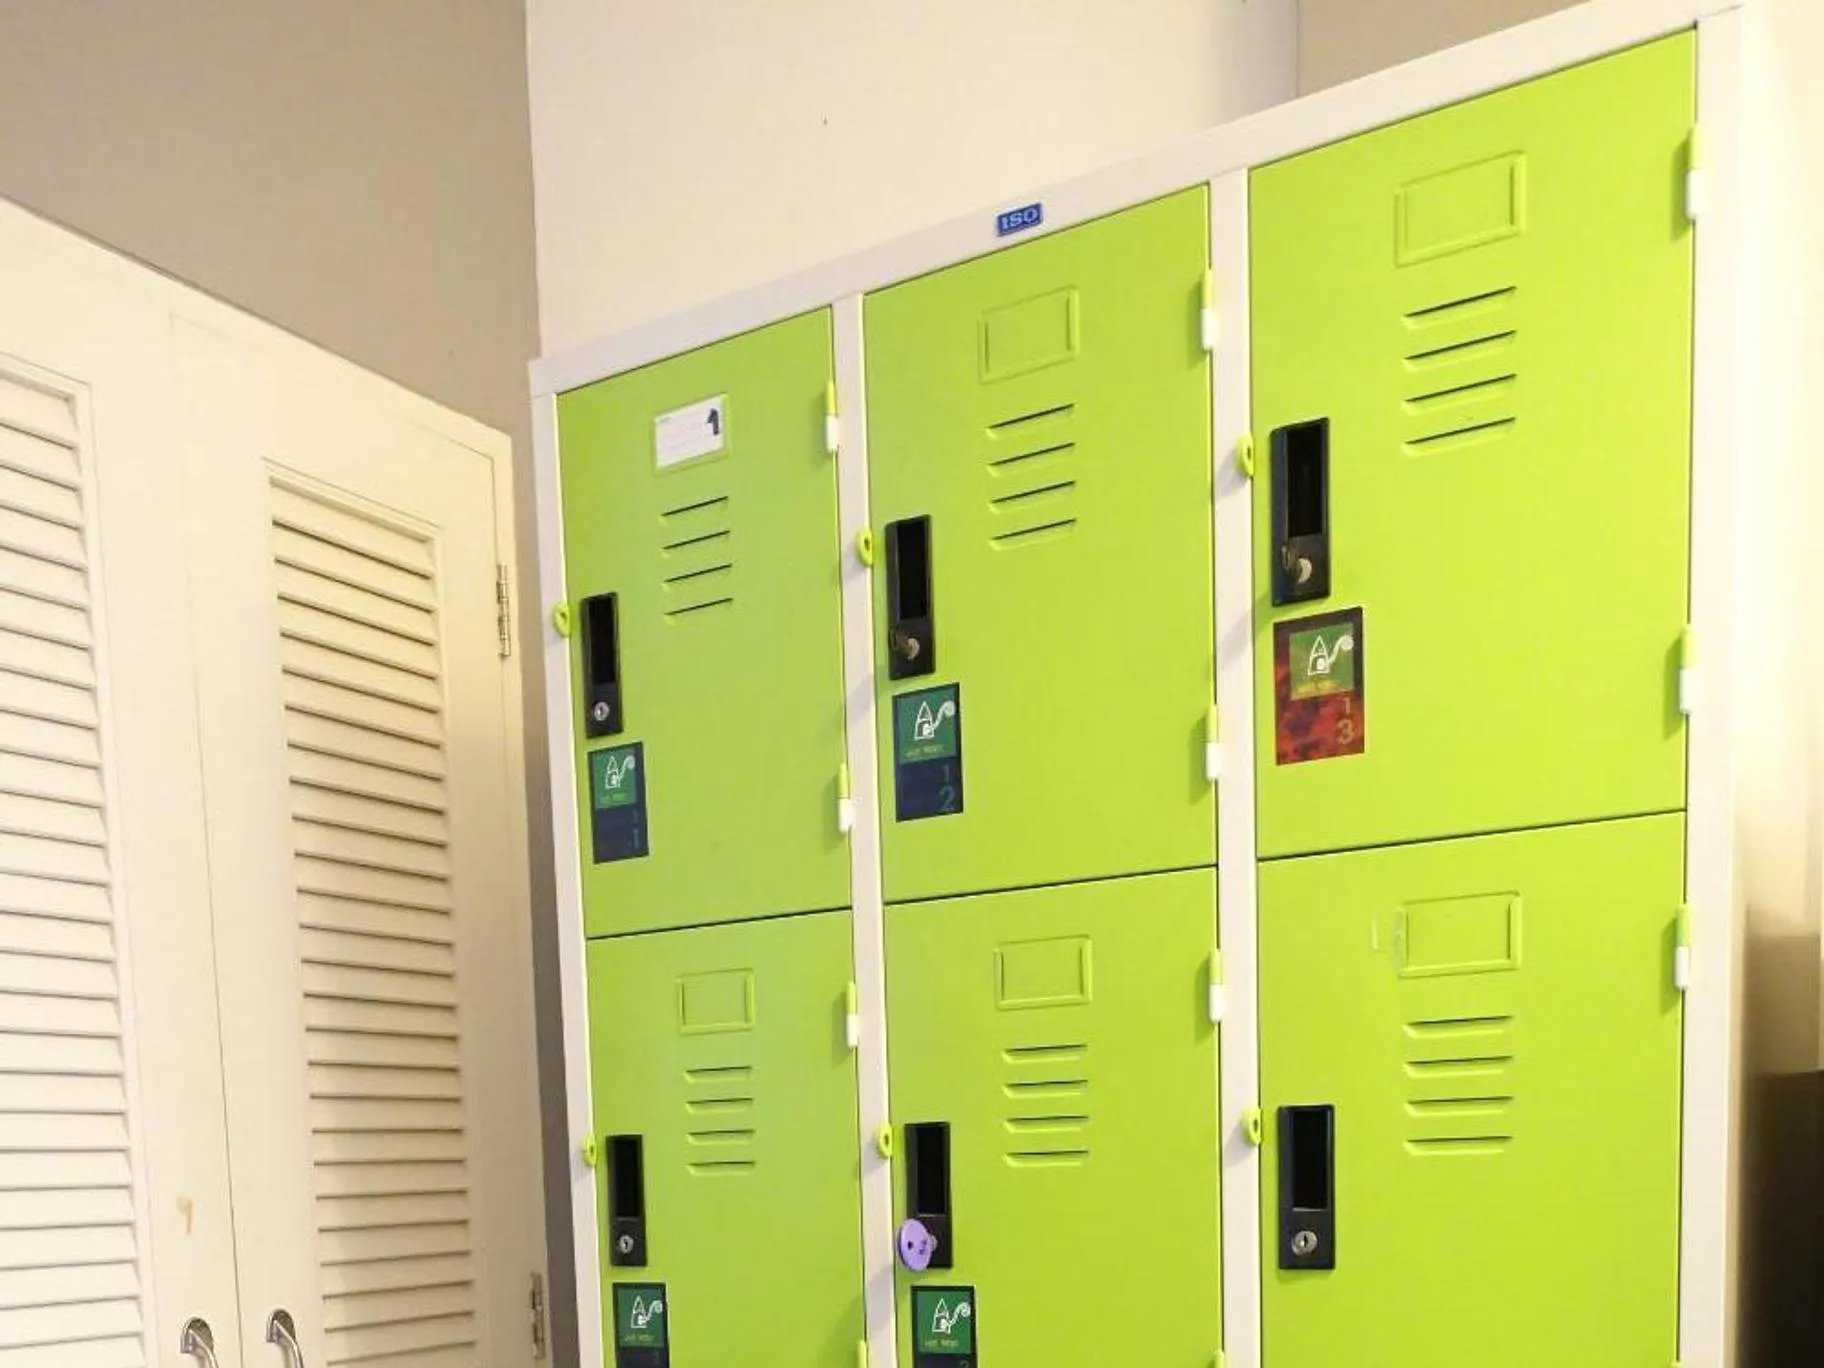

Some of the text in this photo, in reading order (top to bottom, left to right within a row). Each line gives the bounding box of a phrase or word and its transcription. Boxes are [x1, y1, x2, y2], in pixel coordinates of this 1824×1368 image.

[1002, 208, 1038, 229] ISO
[706, 408, 720, 436] 1
[1337, 718, 1354, 745] 3
[939, 784, 956, 813] 2
